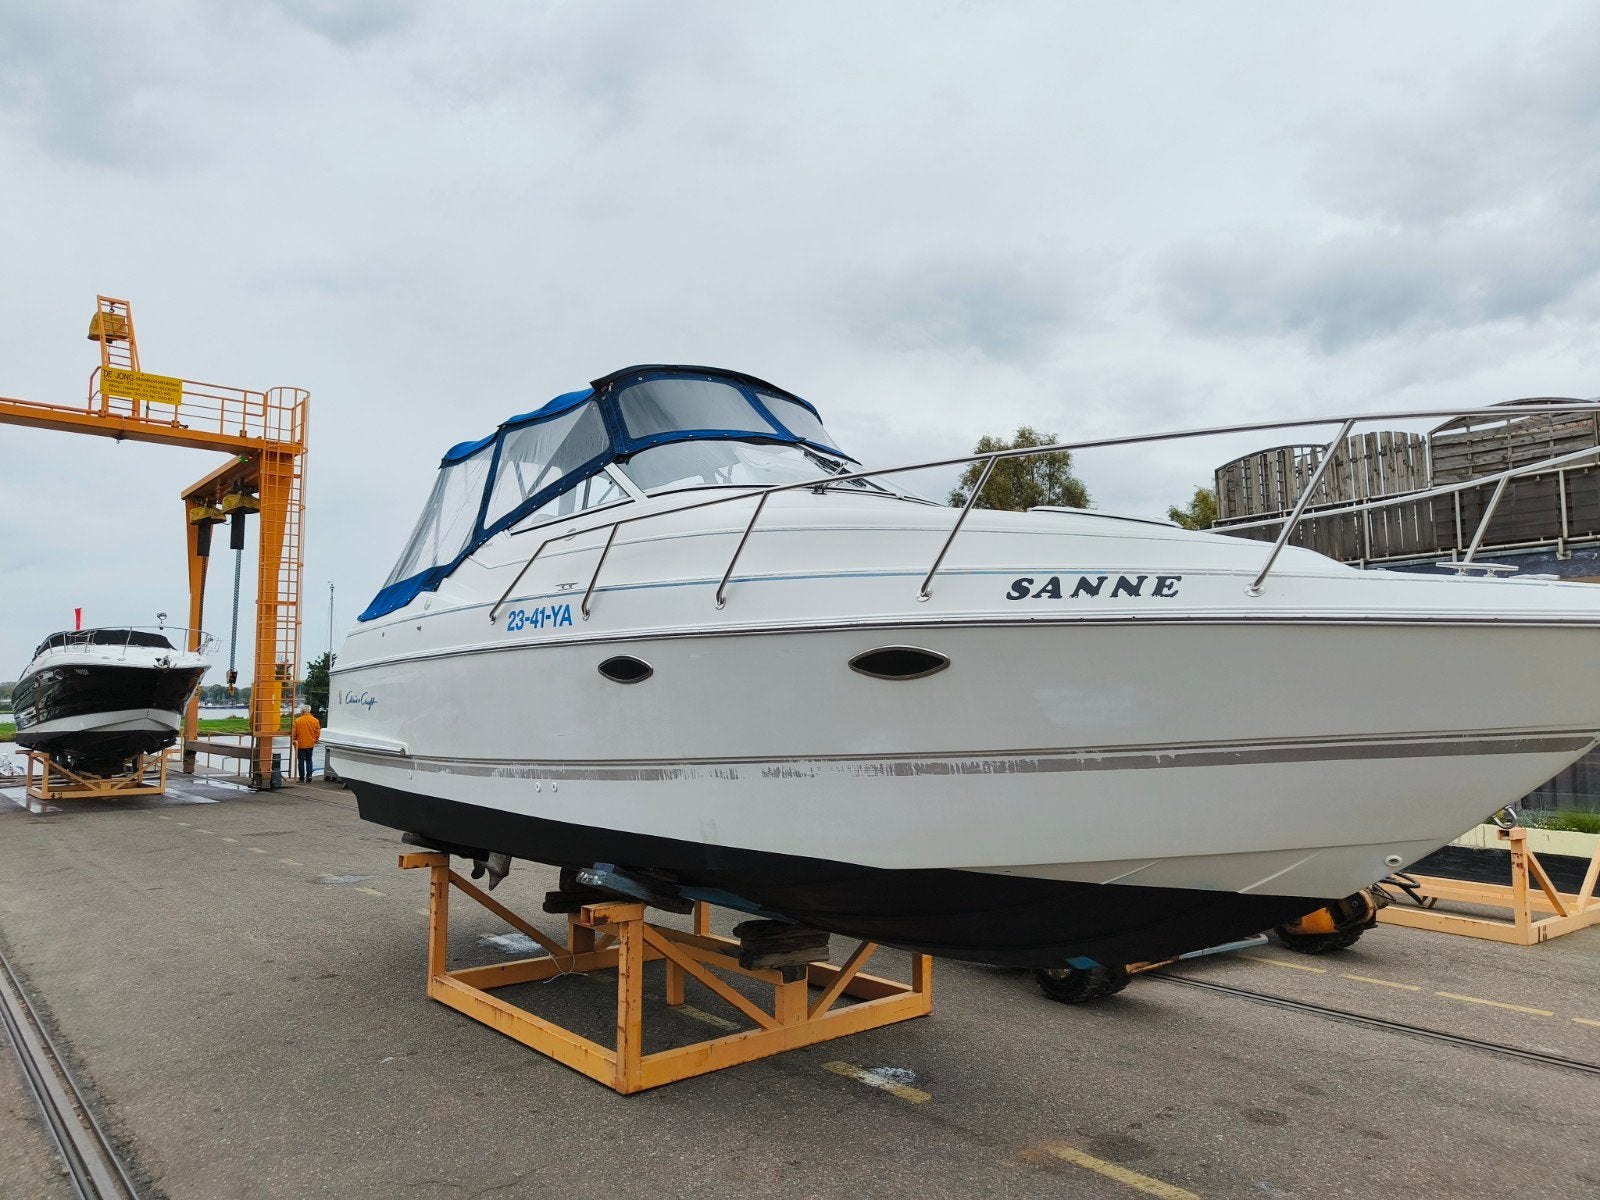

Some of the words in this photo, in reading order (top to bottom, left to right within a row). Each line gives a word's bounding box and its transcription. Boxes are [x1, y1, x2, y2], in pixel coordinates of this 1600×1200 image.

[115, 372, 134, 382] JONG
[1005, 575, 1183, 601] SANNE
[506, 603, 573, 632] 23-41-YA
